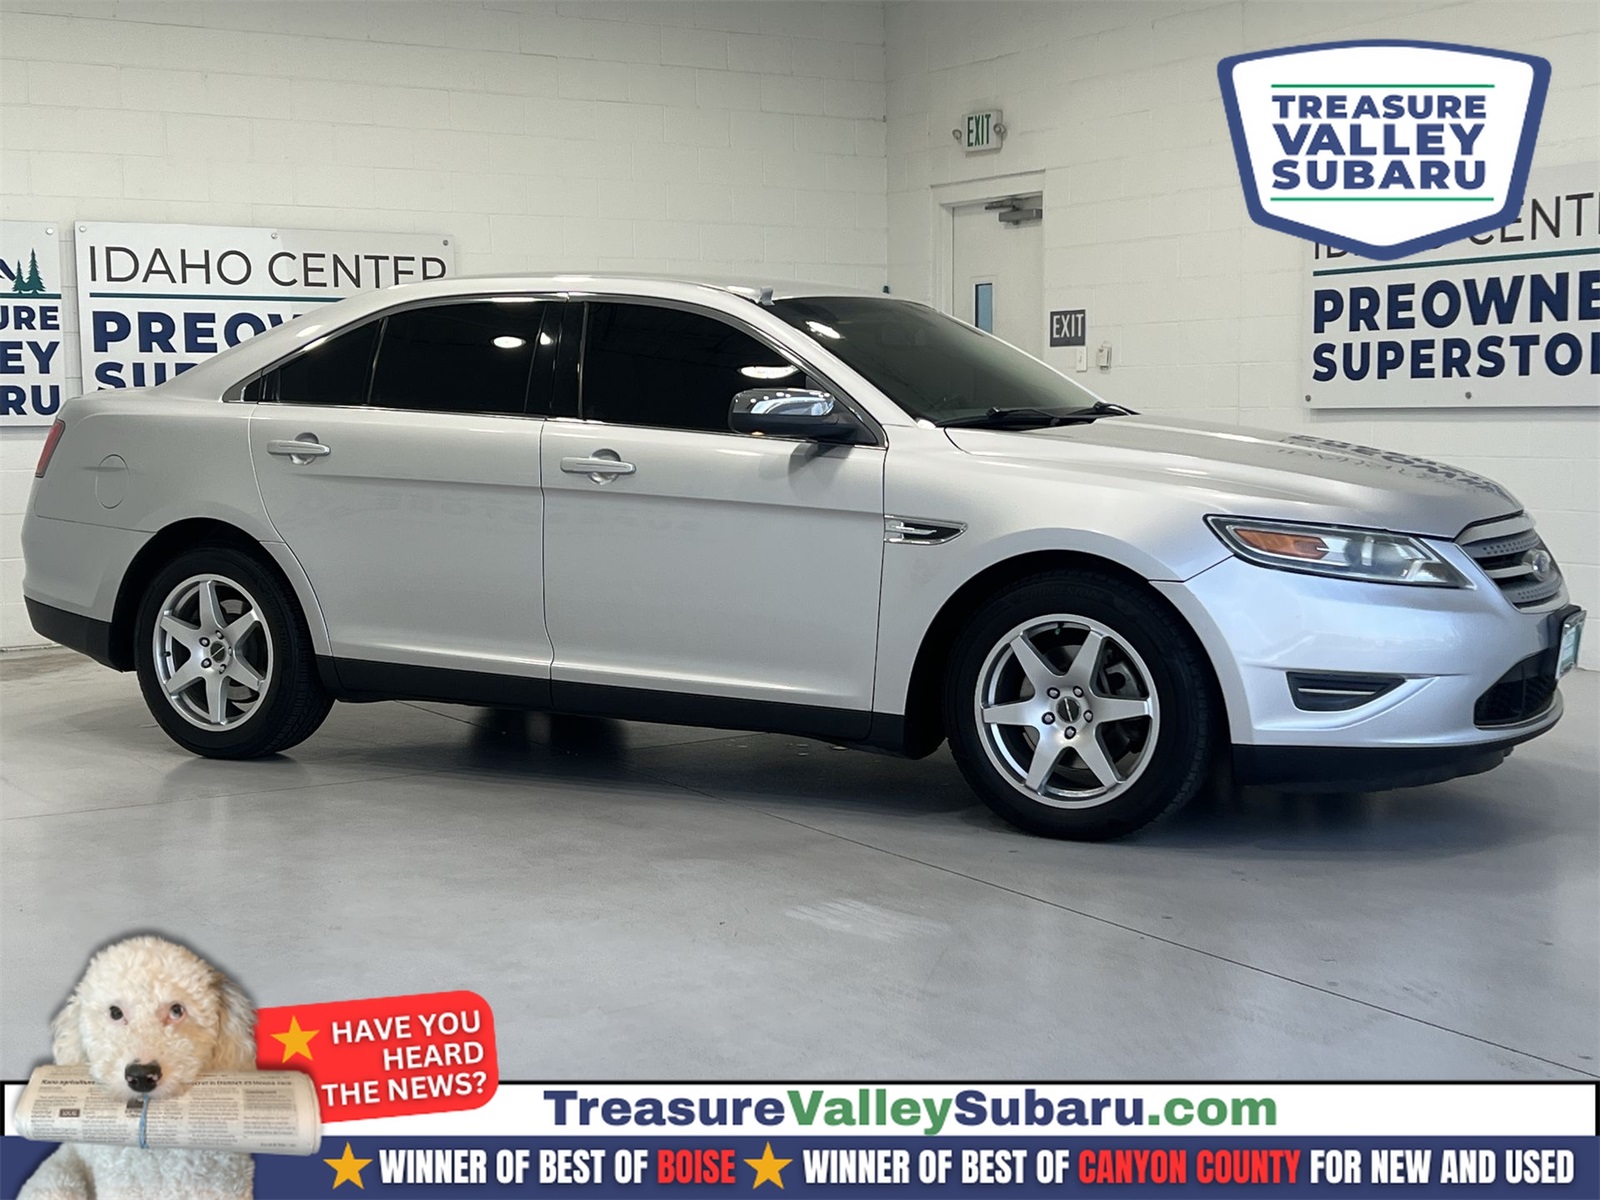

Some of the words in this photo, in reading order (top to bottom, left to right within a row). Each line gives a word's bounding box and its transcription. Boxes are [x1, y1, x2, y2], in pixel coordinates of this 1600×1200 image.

[967, 113, 991, 147] EXIT
[90, 246, 252, 285] IDAHO
[1053, 313, 1084, 338] EXIT
